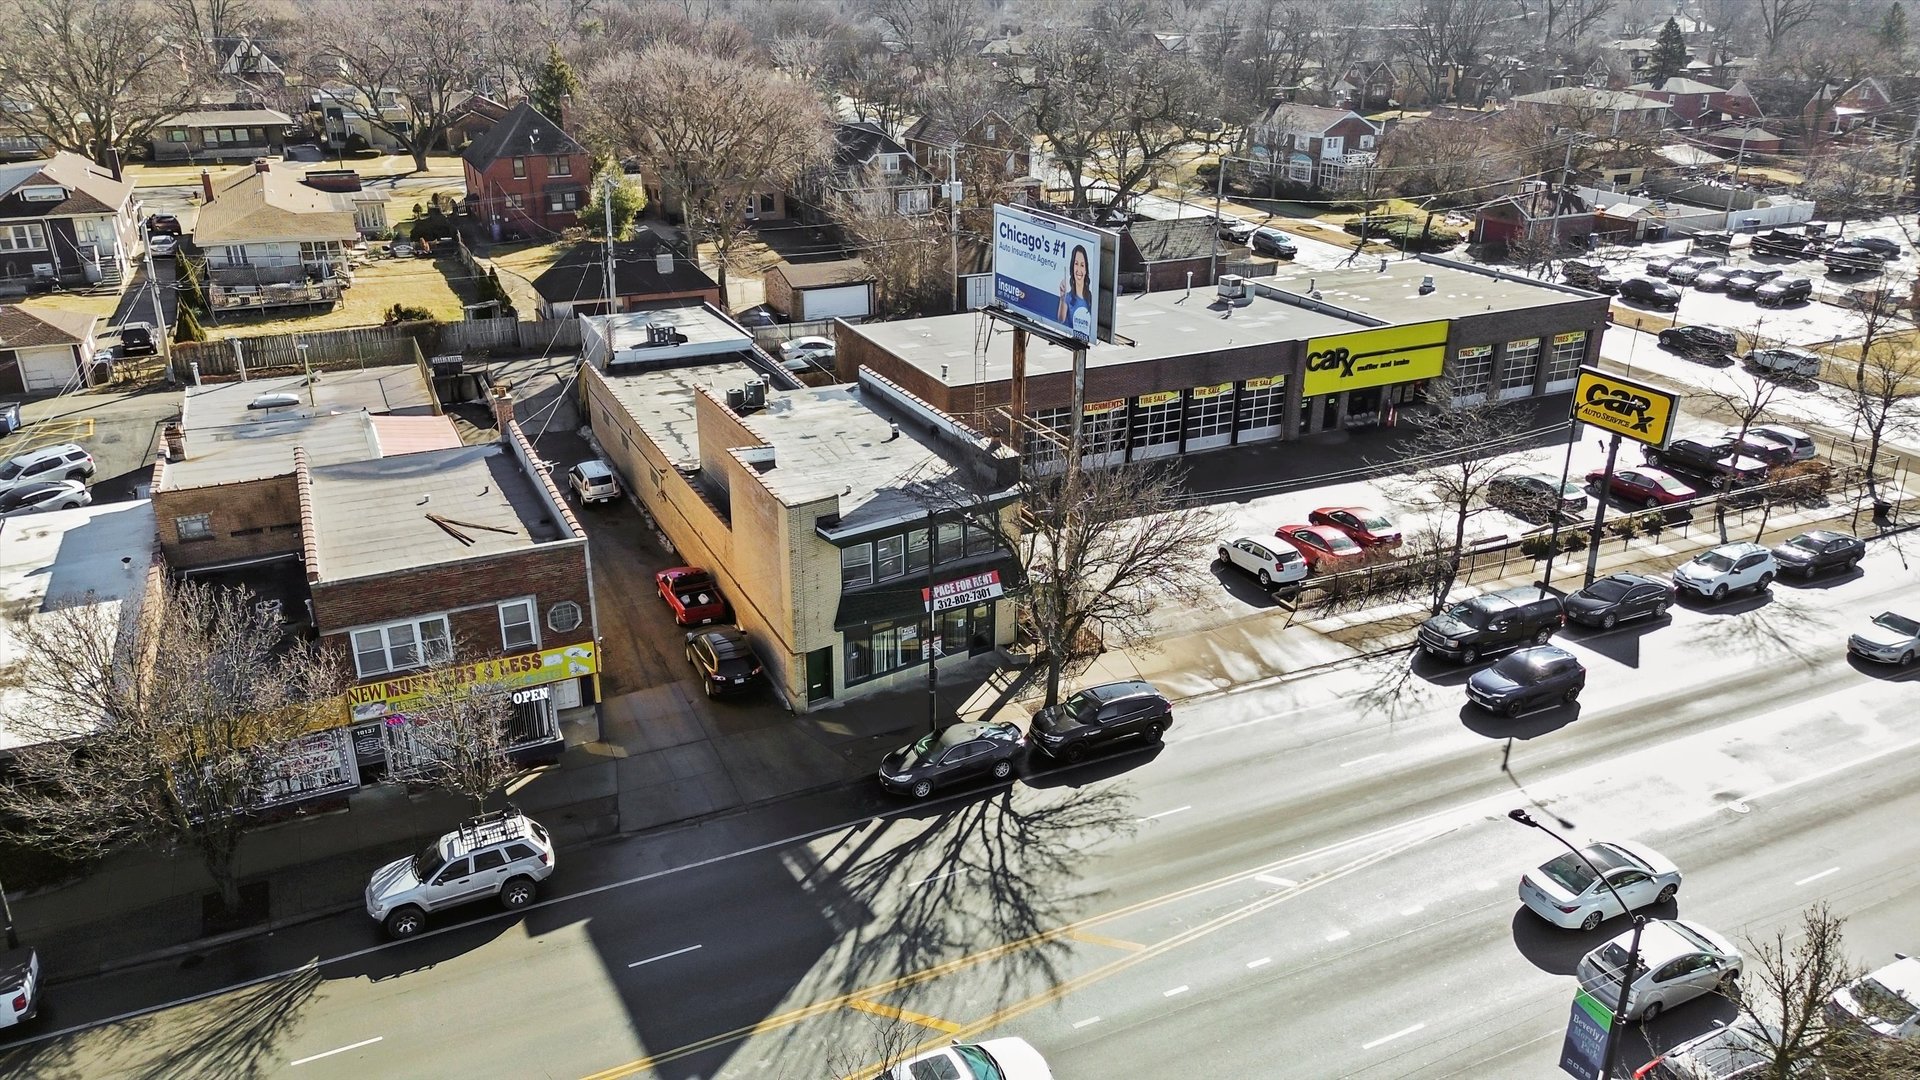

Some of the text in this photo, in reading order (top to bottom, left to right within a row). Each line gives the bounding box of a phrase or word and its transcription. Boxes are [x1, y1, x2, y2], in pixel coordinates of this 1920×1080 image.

[1000, 222, 1050, 252] Chicago's
[1053, 239, 1066, 258] #1
[999, 241, 1057, 271] Auto Insurance Agency
[998, 278, 1020, 297] insure
[1518, 340, 1529, 348] SALE
[1357, 363, 1379, 371] muffler
[1380, 360, 1392, 368] and
[1195, 388, 1206, 397] TIRE
[1247, 380, 1258, 388] TIRE
[1084, 399, 1124, 412] ALIGNMENTS
[1140, 394, 1167, 405] TIRE SALE
[1583, 407, 1631, 428] AUTO SERVICE
[932, 573, 993, 598] PACE FOR RENT
[937, 588, 991, 609] 312-802-7301
[347, 683, 381, 706] NEW
[513, 687, 550, 705] OPEN
[1573, 1013, 1605, 1043] Beverly/
[1580, 1040, 1598, 1060] Park
